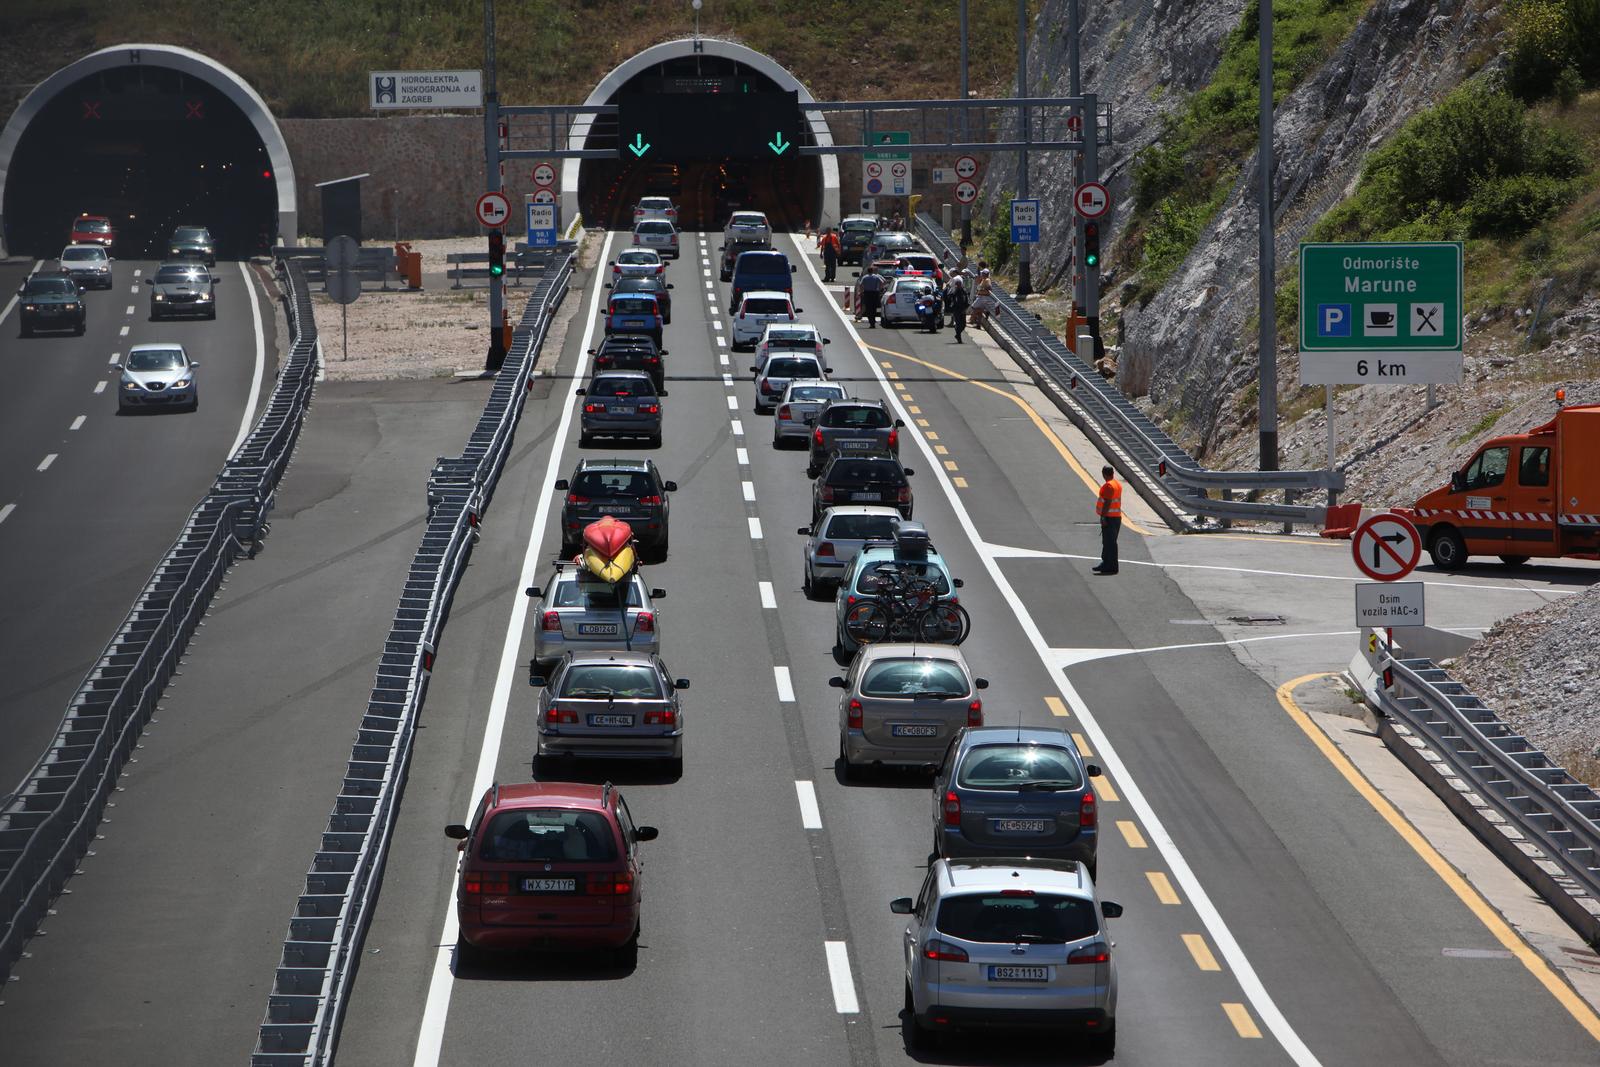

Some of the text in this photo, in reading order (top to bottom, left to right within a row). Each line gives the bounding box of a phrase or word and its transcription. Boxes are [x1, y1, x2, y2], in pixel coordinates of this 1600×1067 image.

[401, 76, 459, 84] HIDROELEKTRA
[401, 85, 460, 94] NISKOGRADNJA
[401, 95, 432, 103] ZAGREB
[531, 208, 552, 216] Radio
[1343, 256, 1420, 270] Odmorište
[1344, 276, 1417, 293] Marune
[1325, 308, 1344, 332] P
[1357, 359, 1406, 376] 6 km
[1379, 594, 1400, 604] Osim
[1362, 605, 1418, 616] vozila HAC-a
[1021, 968, 1043, 978] 1113
